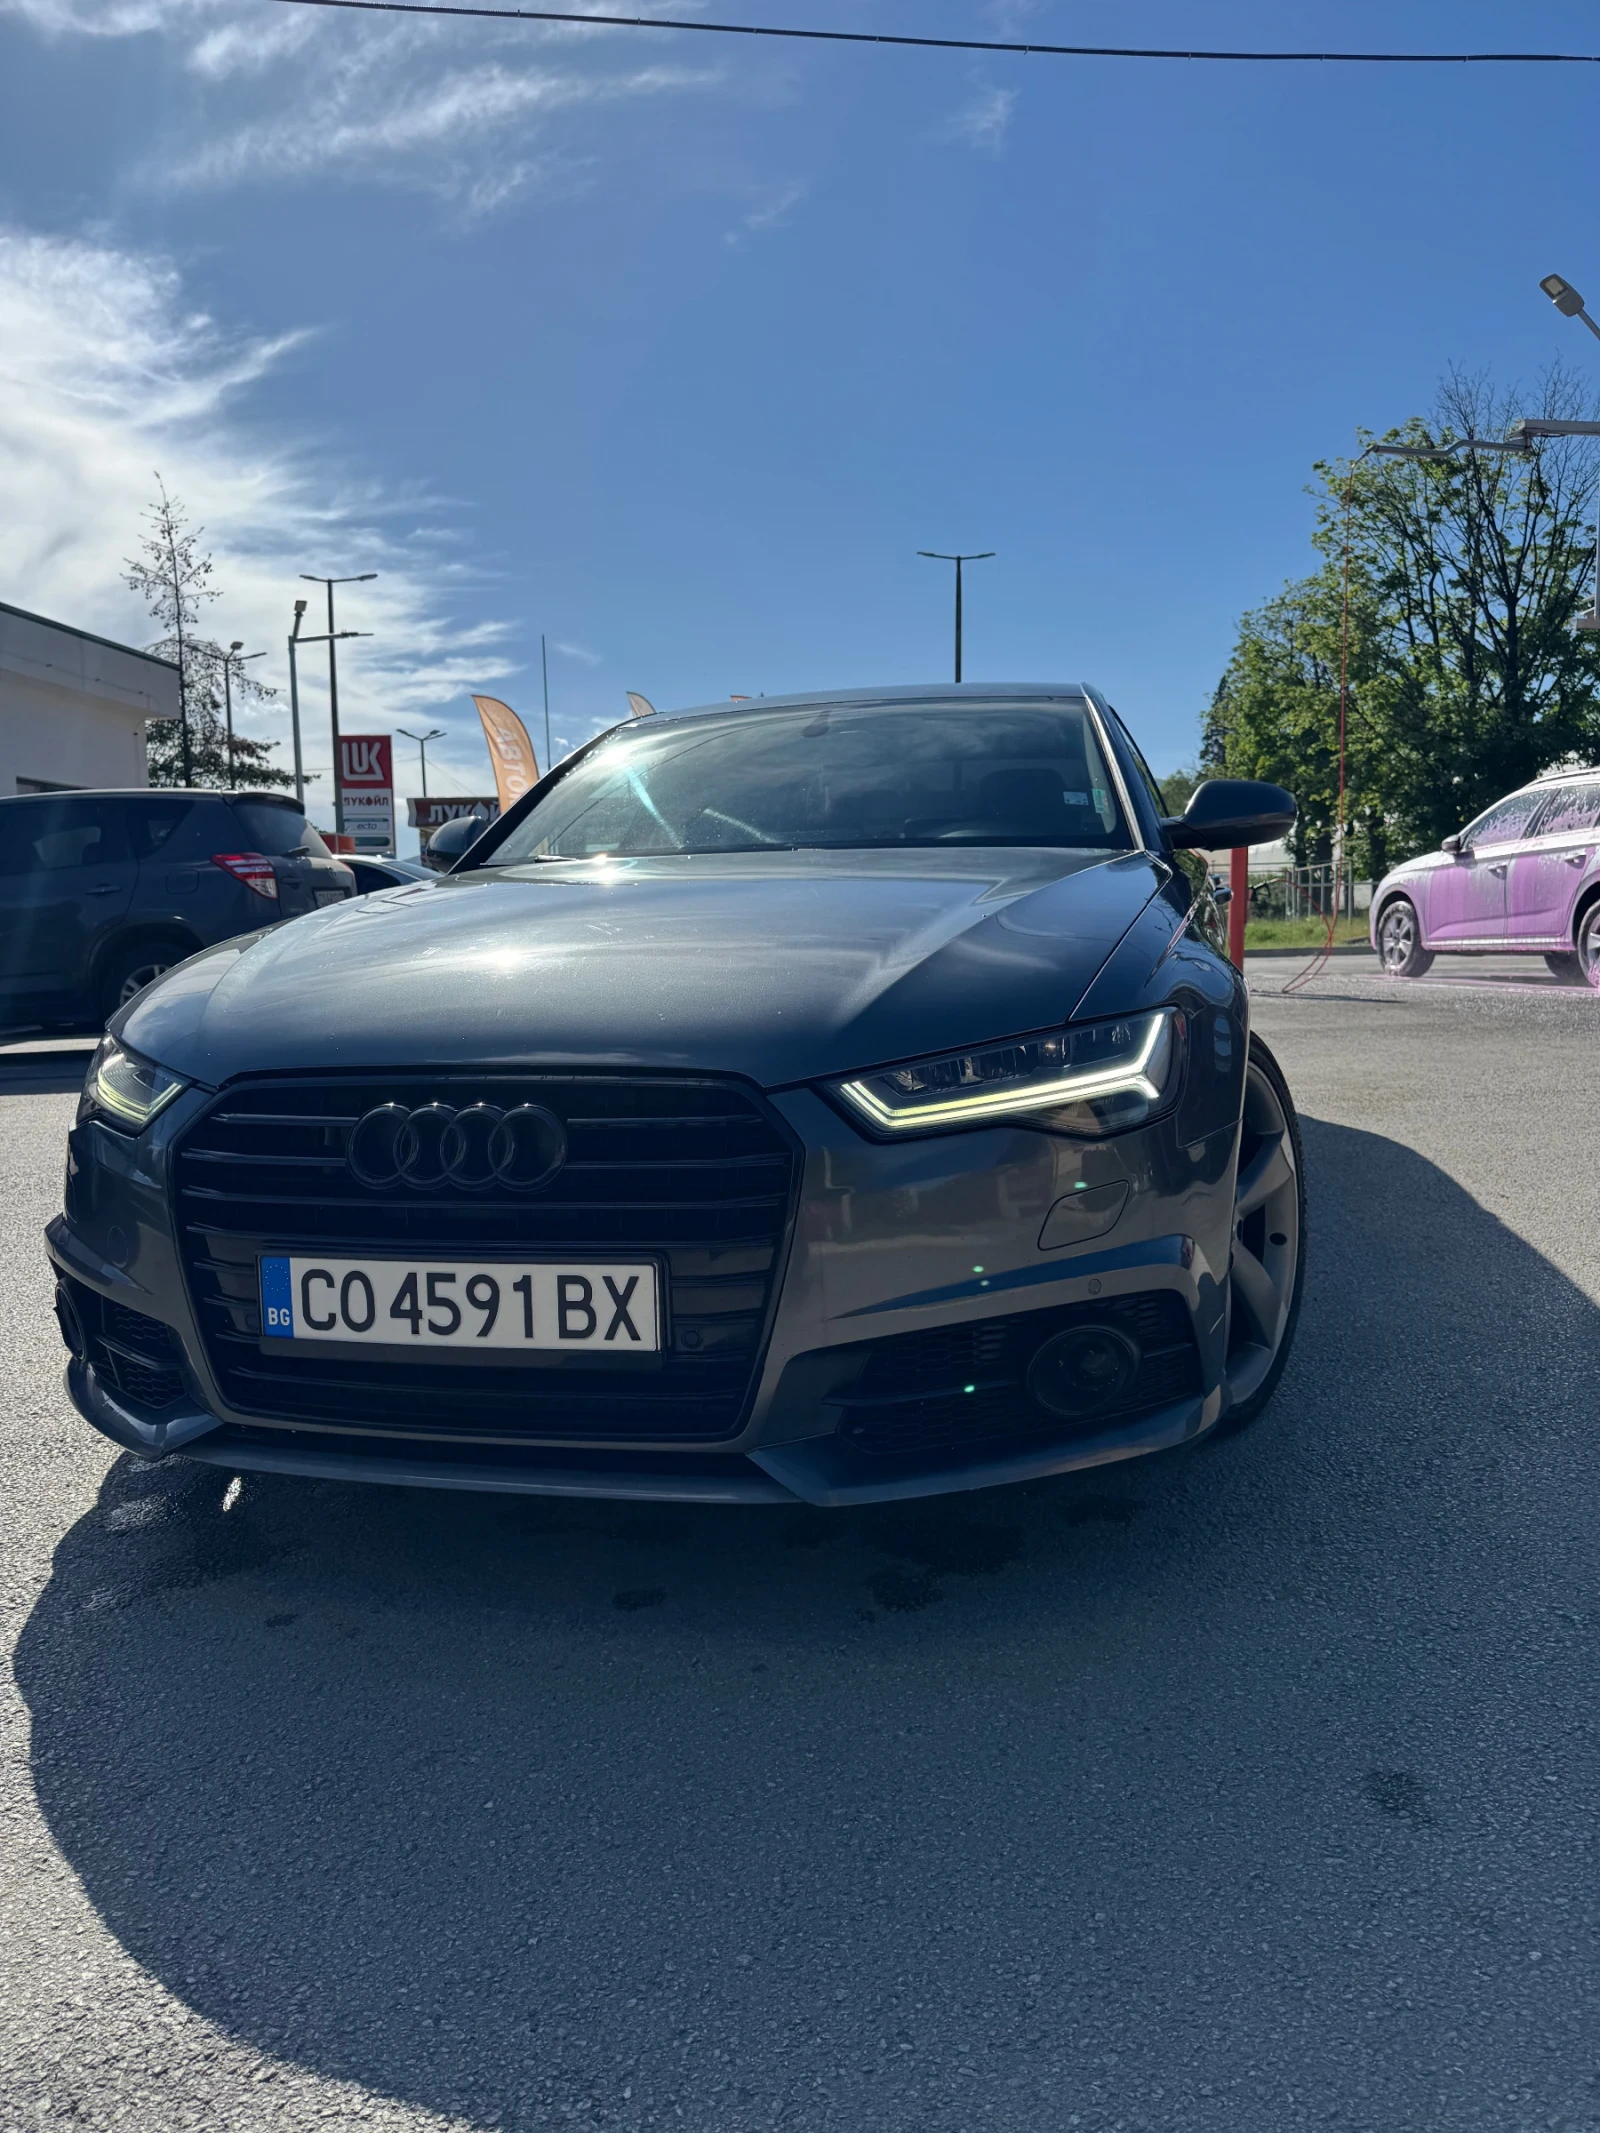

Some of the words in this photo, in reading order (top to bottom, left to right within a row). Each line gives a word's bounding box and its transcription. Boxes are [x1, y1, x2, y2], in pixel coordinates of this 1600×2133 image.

[343, 795, 389, 807] ЛУКОЙЛ
[357, 822, 378, 830] ecto
[390, 1272, 534, 1338] 4591
[557, 1275, 641, 1341] BX
[267, 1308, 291, 1326] BG
